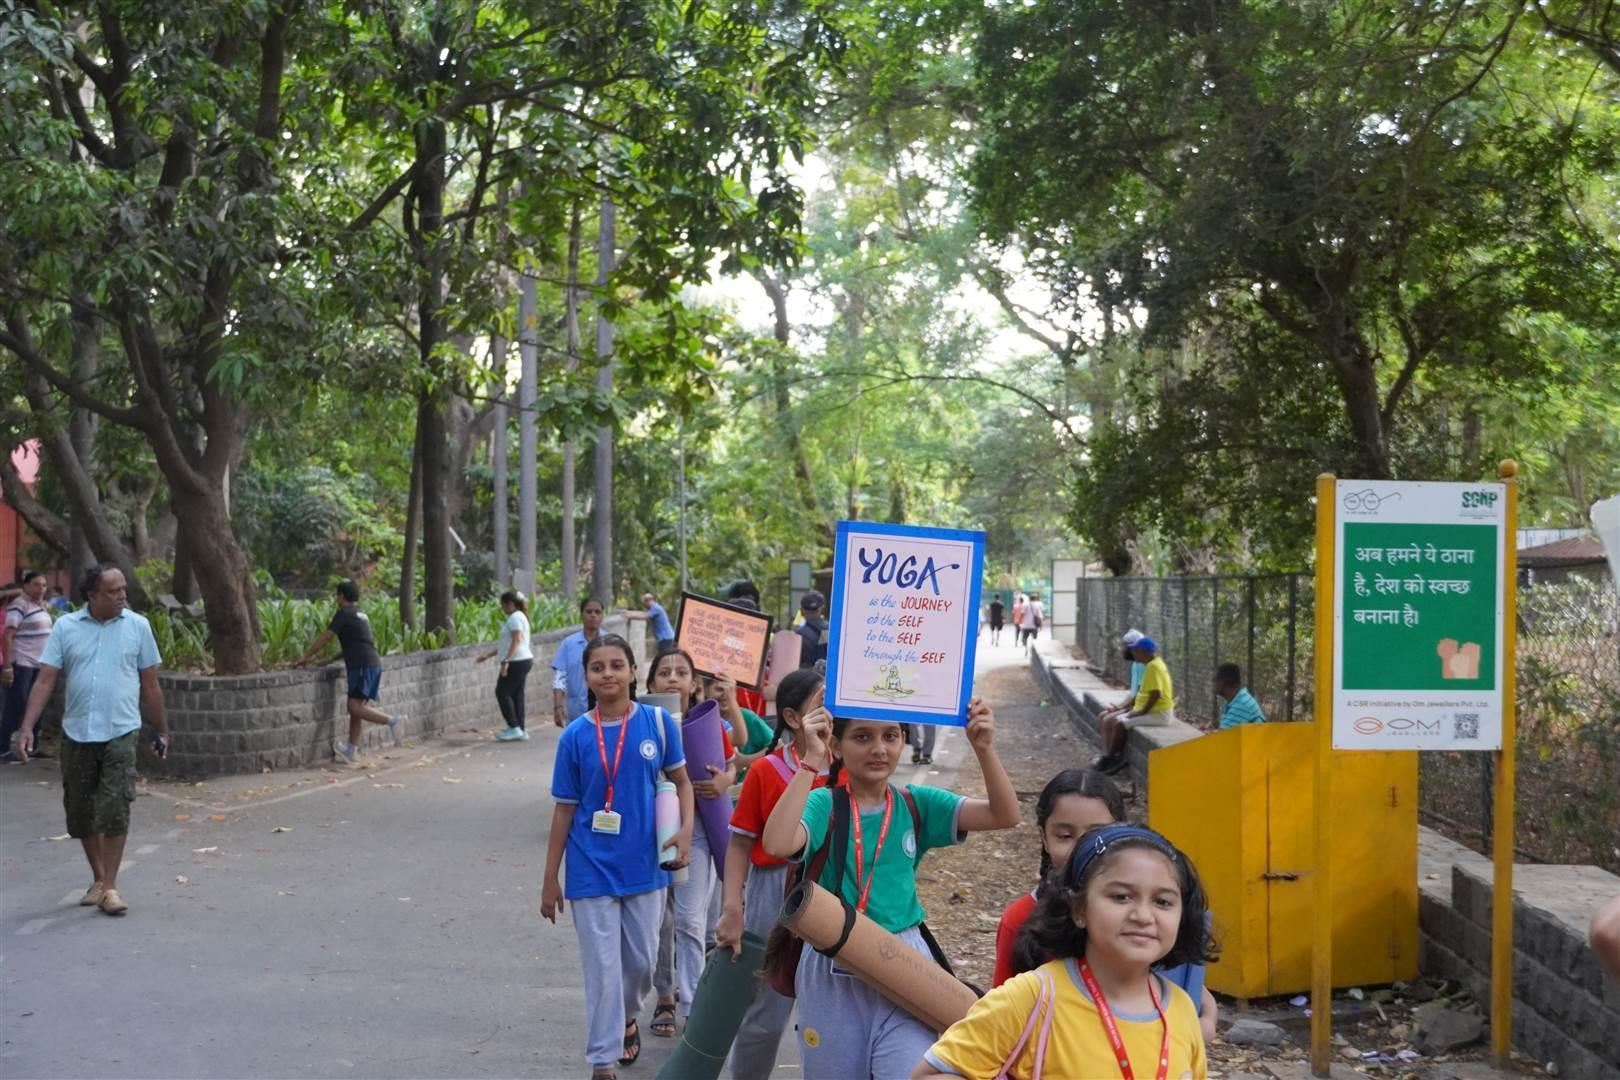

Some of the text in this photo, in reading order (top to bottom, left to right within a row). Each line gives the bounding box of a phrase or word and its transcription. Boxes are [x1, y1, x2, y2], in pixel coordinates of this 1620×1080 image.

[1354, 543, 1475, 566] अब हमने ये ठाना
[859, 547, 960, 595] YOGA
[1374, 573, 1400, 595] देश
[1403, 574, 1425, 594] को
[1427, 579, 1471, 595] स्वच्छ
[880, 592, 897, 608] the
[901, 595, 953, 613] JOURNEY
[880, 613, 896, 627] the
[898, 615, 925, 628] SELF
[1352, 609, 1401, 624] बनाना
[866, 629, 921, 645] to the SELF
[864, 645, 902, 666] through
[919, 652, 947, 664] SELF
